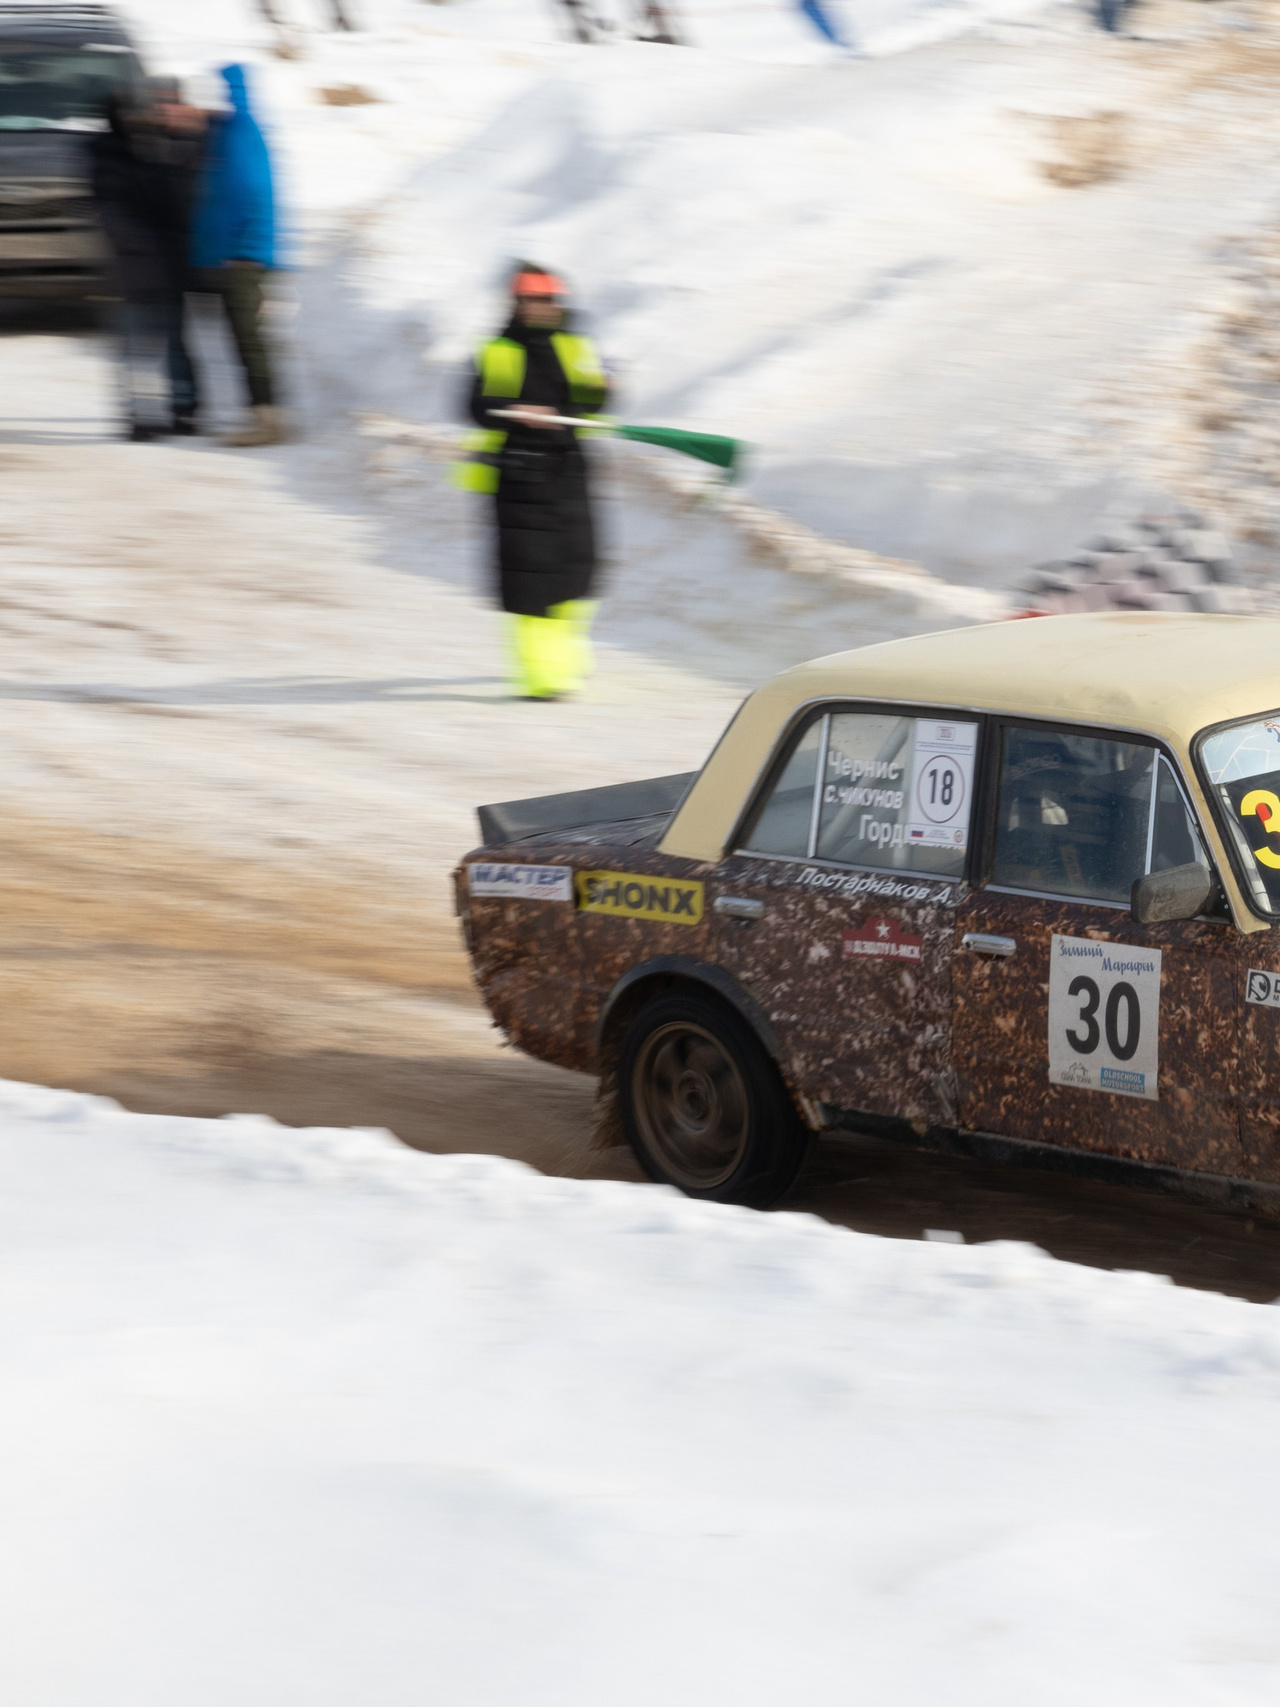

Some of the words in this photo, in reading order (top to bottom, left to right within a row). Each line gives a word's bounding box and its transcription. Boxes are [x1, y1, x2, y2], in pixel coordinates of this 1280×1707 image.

[928, 768, 955, 806] 18
[795, 867, 931, 899] Постарнаков
[1065, 975, 1141, 1061] 30
[1103, 1069, 1142, 1083] OLDSCHOOL
